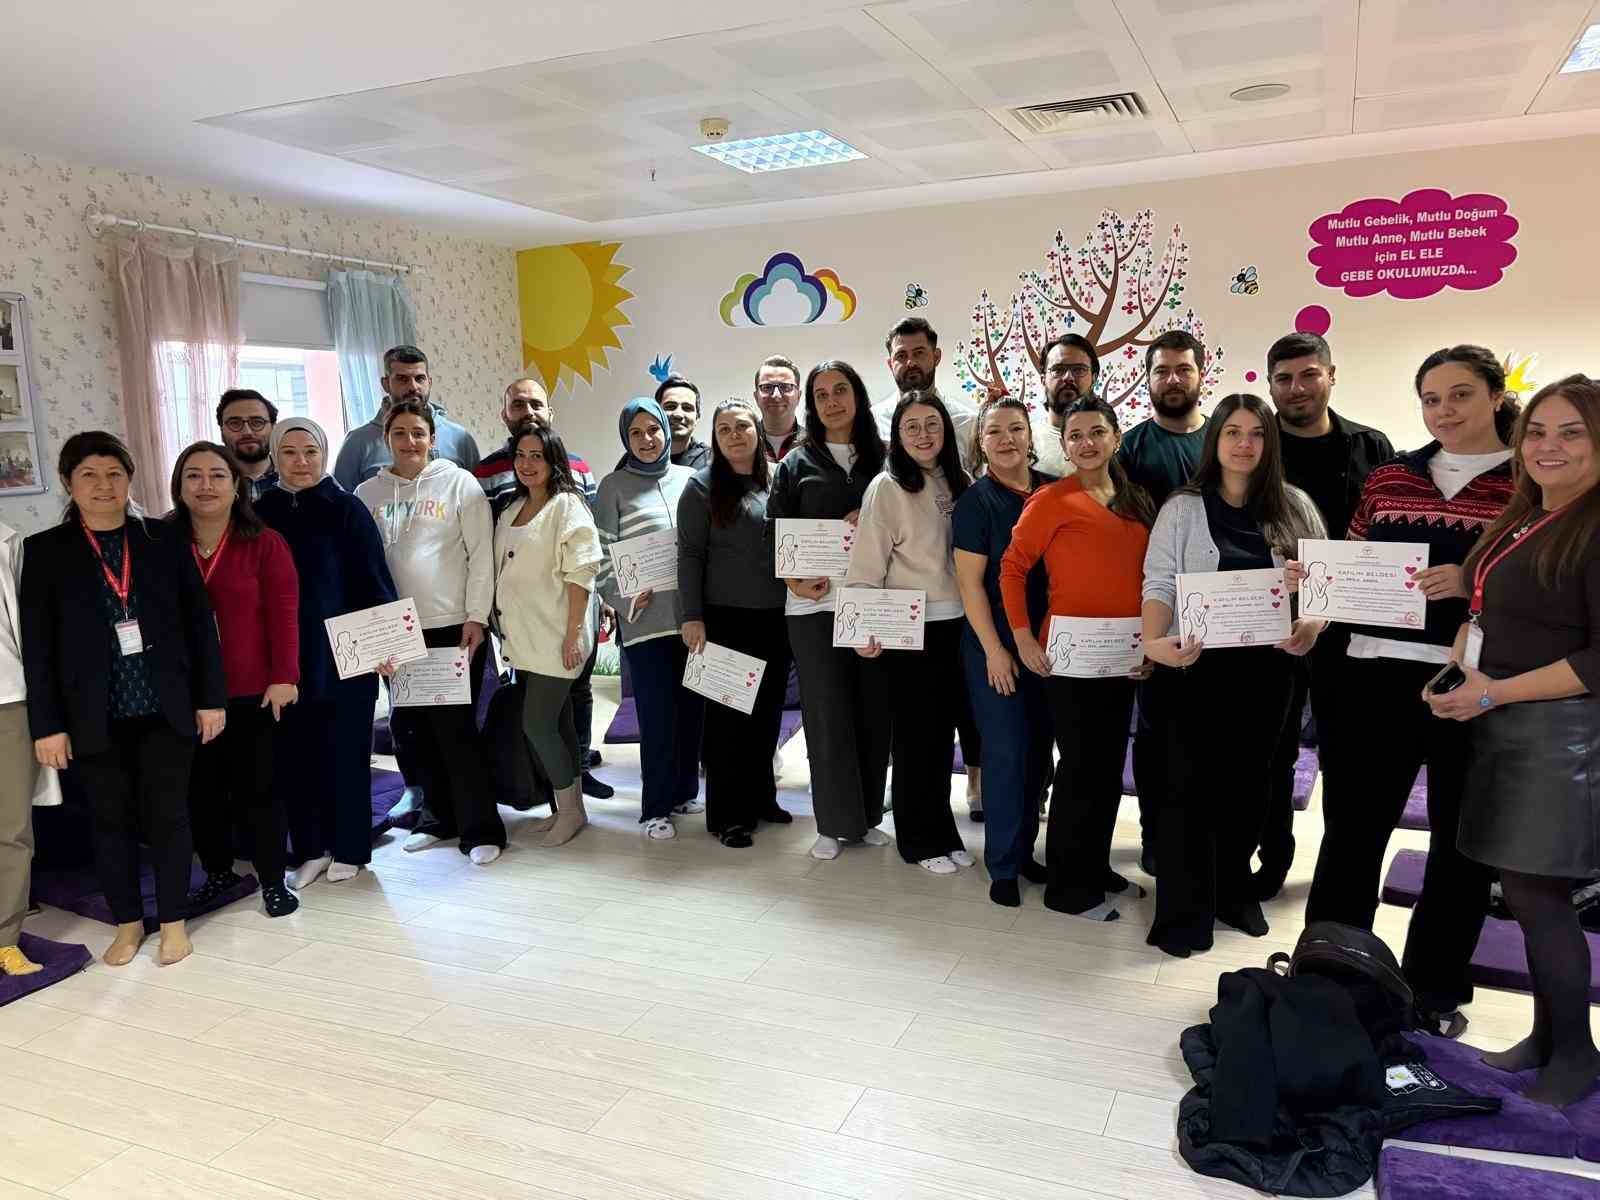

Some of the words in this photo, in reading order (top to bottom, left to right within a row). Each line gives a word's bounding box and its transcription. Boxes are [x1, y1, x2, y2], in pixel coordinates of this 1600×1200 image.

[1328, 216, 1360, 230] Mutlu
[1364, 213, 1413, 227] Gebelik,
[1417, 210, 1451, 223] Mutlu
[1455, 208, 1498, 220] Doğum
[1336, 234, 1369, 248] Mutlu
[1371, 232, 1407, 246] Anne,
[1410, 229, 1444, 242] Mutlu
[1447, 226, 1487, 239] Bebek
[1375, 251, 1397, 264] için
[1401, 249, 1416, 260] EL
[1419, 247, 1443, 259] ELE
[1340, 269, 1374, 282] GEBE
[1377, 265, 1477, 280] OKULUMUZDA...
[404, 500, 446, 519] YORK
